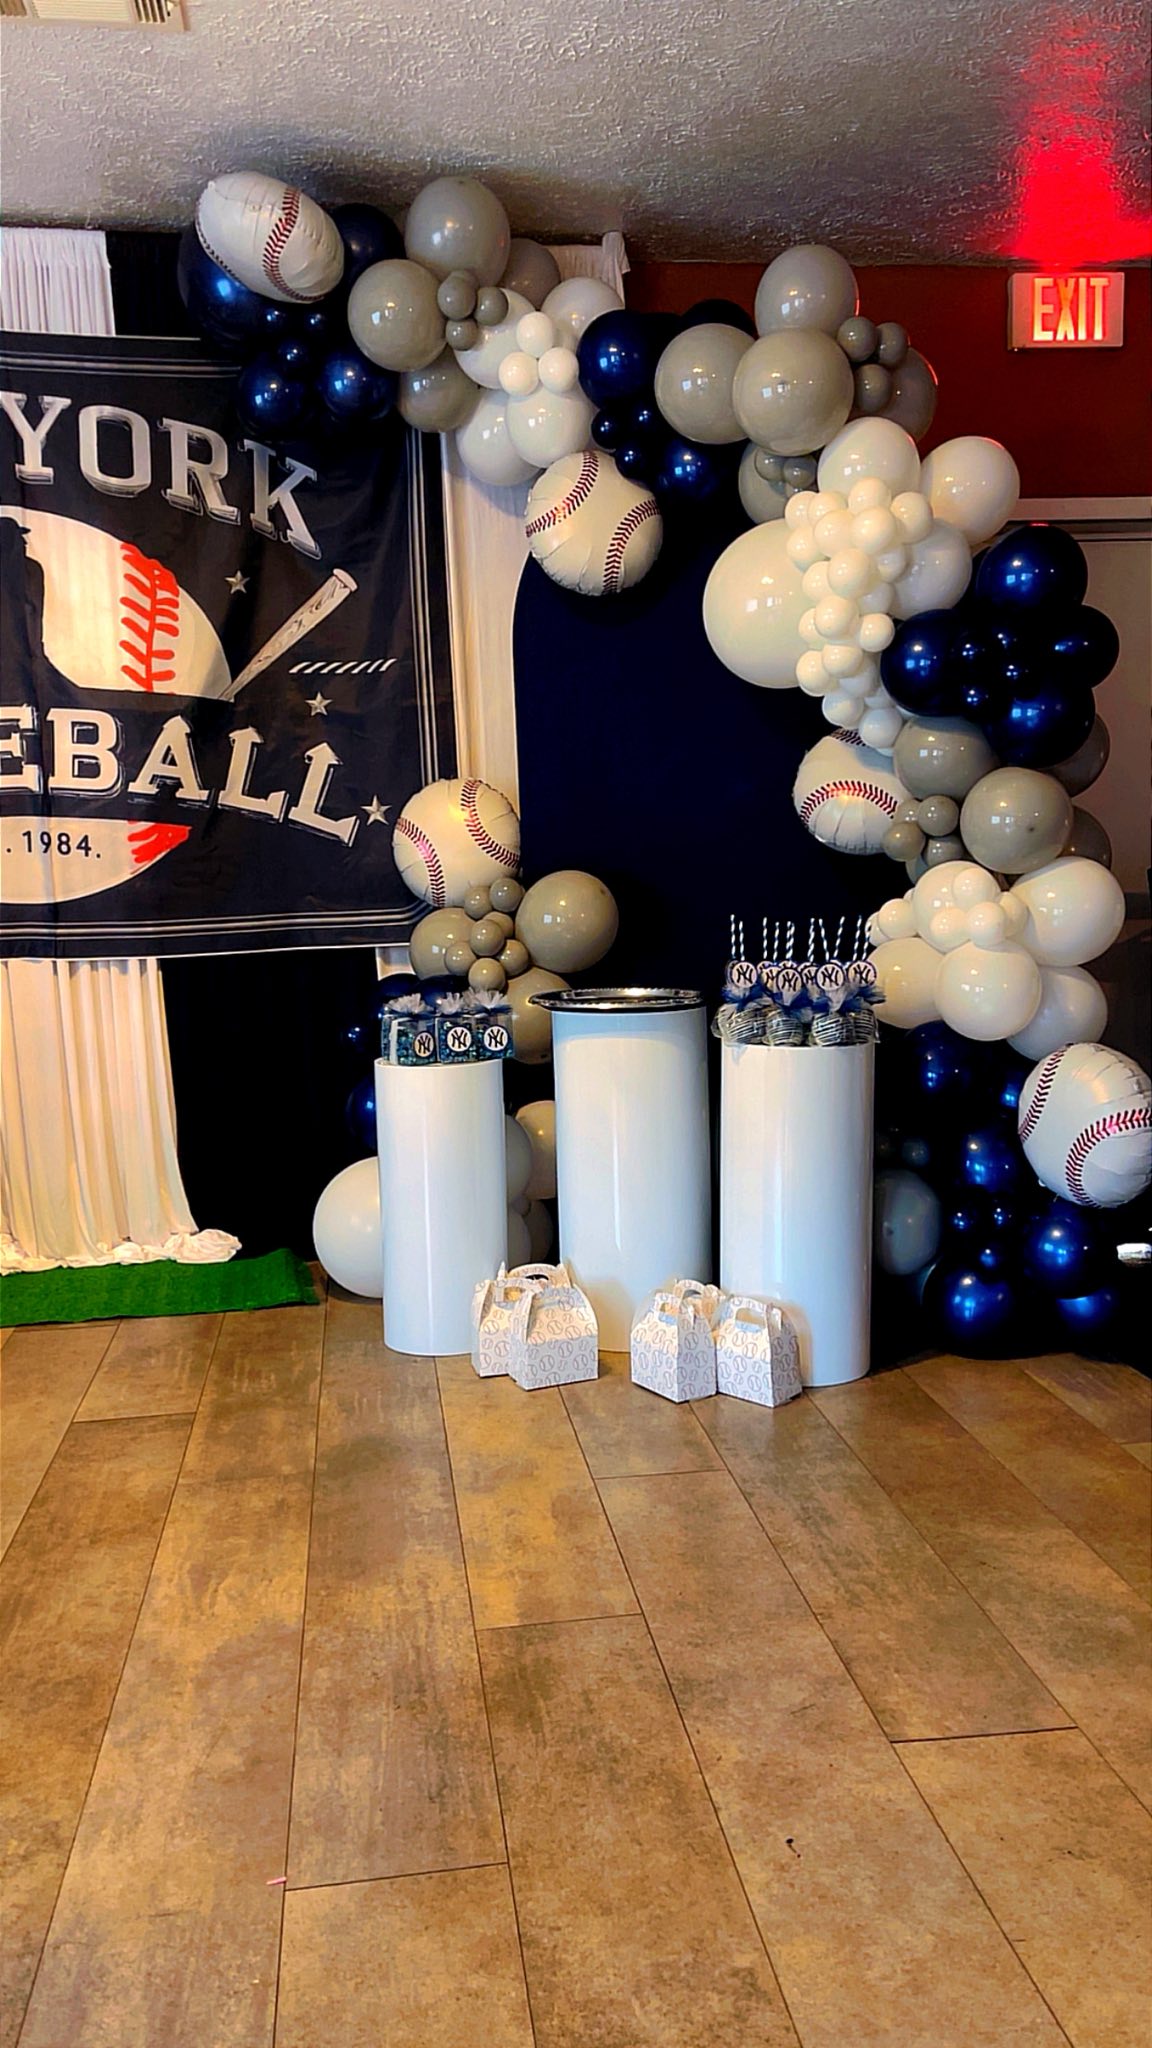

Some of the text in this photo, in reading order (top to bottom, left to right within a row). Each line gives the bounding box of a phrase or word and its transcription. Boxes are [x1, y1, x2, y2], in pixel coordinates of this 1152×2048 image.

[1033, 277, 1109, 341] EXIT
[0, 390, 322, 560] YORK
[0, 703, 361, 847] EBALL
[821, 966, 840, 987] NY
[417, 1034, 431, 1055] NY
[450, 1029, 468, 1049] NY
[487, 1028, 505, 1049] NY
